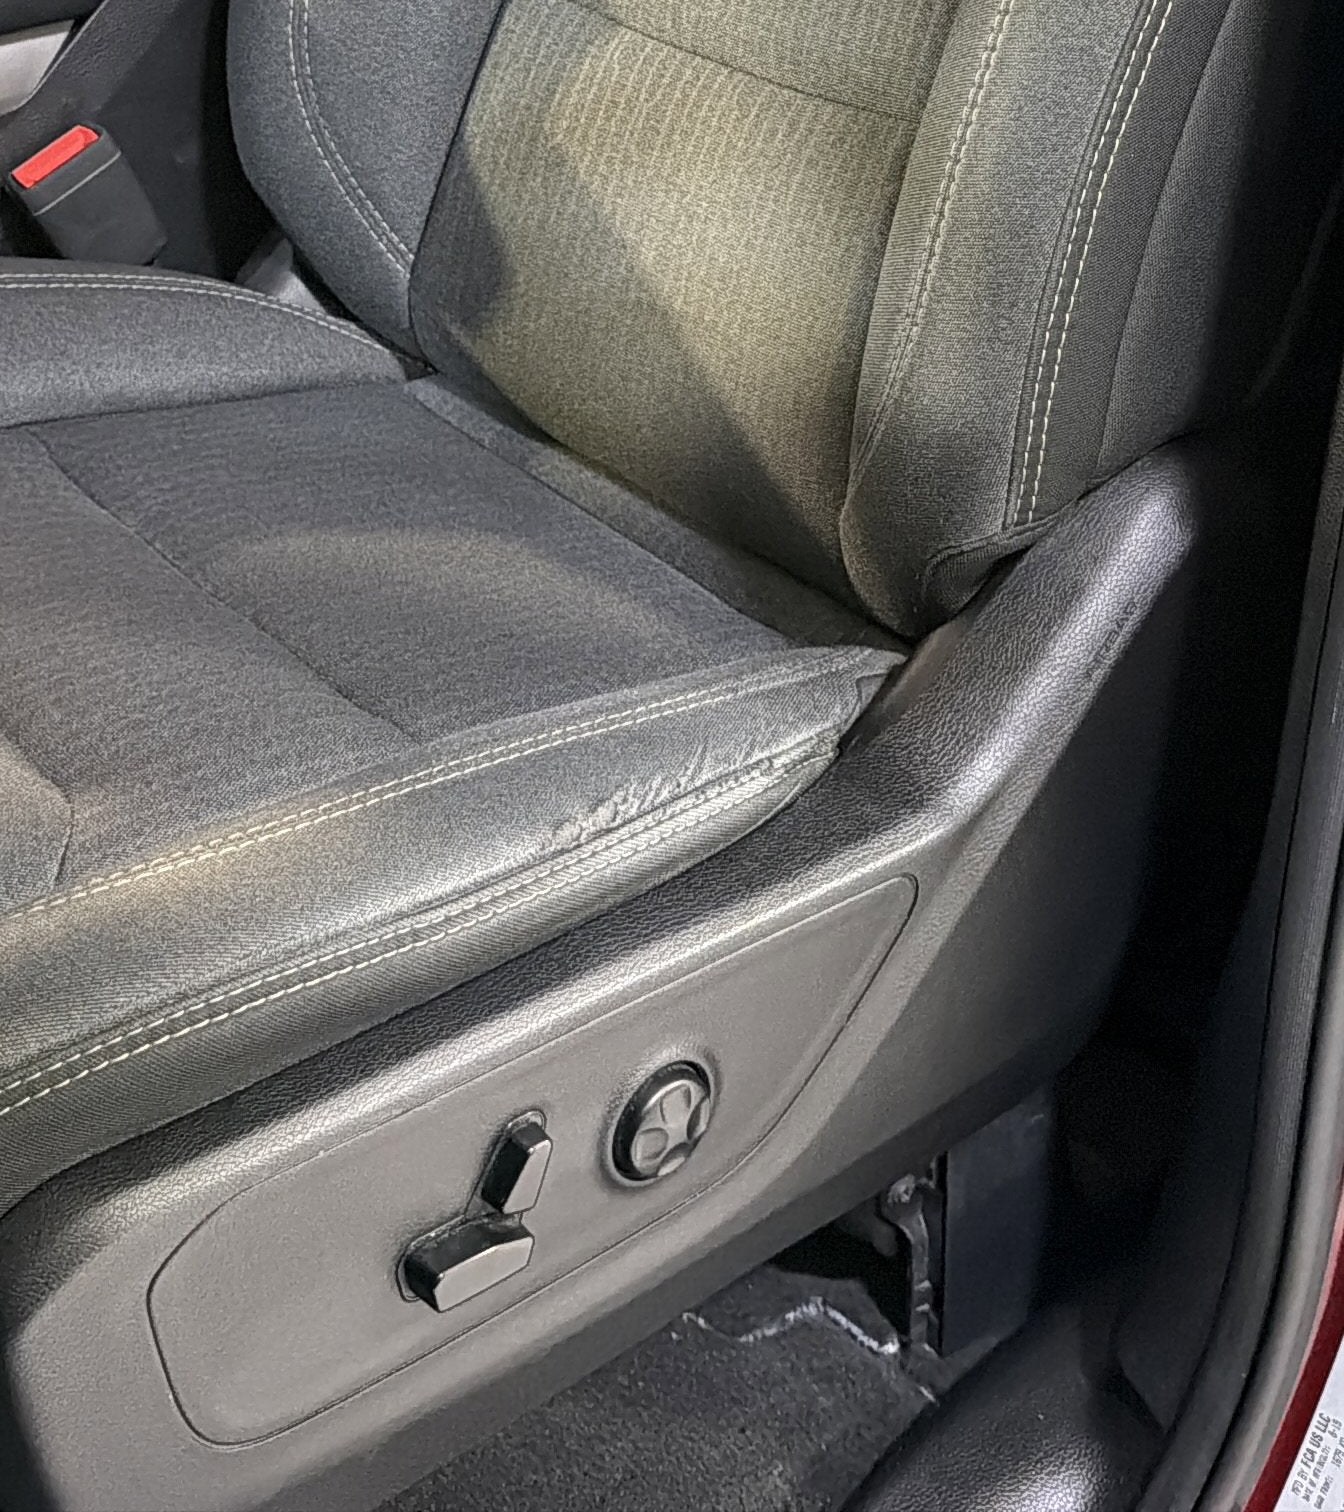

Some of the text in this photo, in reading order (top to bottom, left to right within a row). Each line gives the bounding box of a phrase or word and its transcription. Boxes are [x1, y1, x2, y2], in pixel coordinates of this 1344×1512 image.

[1313, 1410, 1332, 1435] LLC
[1307, 1429, 1324, 1450] US
[1298, 1444, 1318, 1470] FCA
